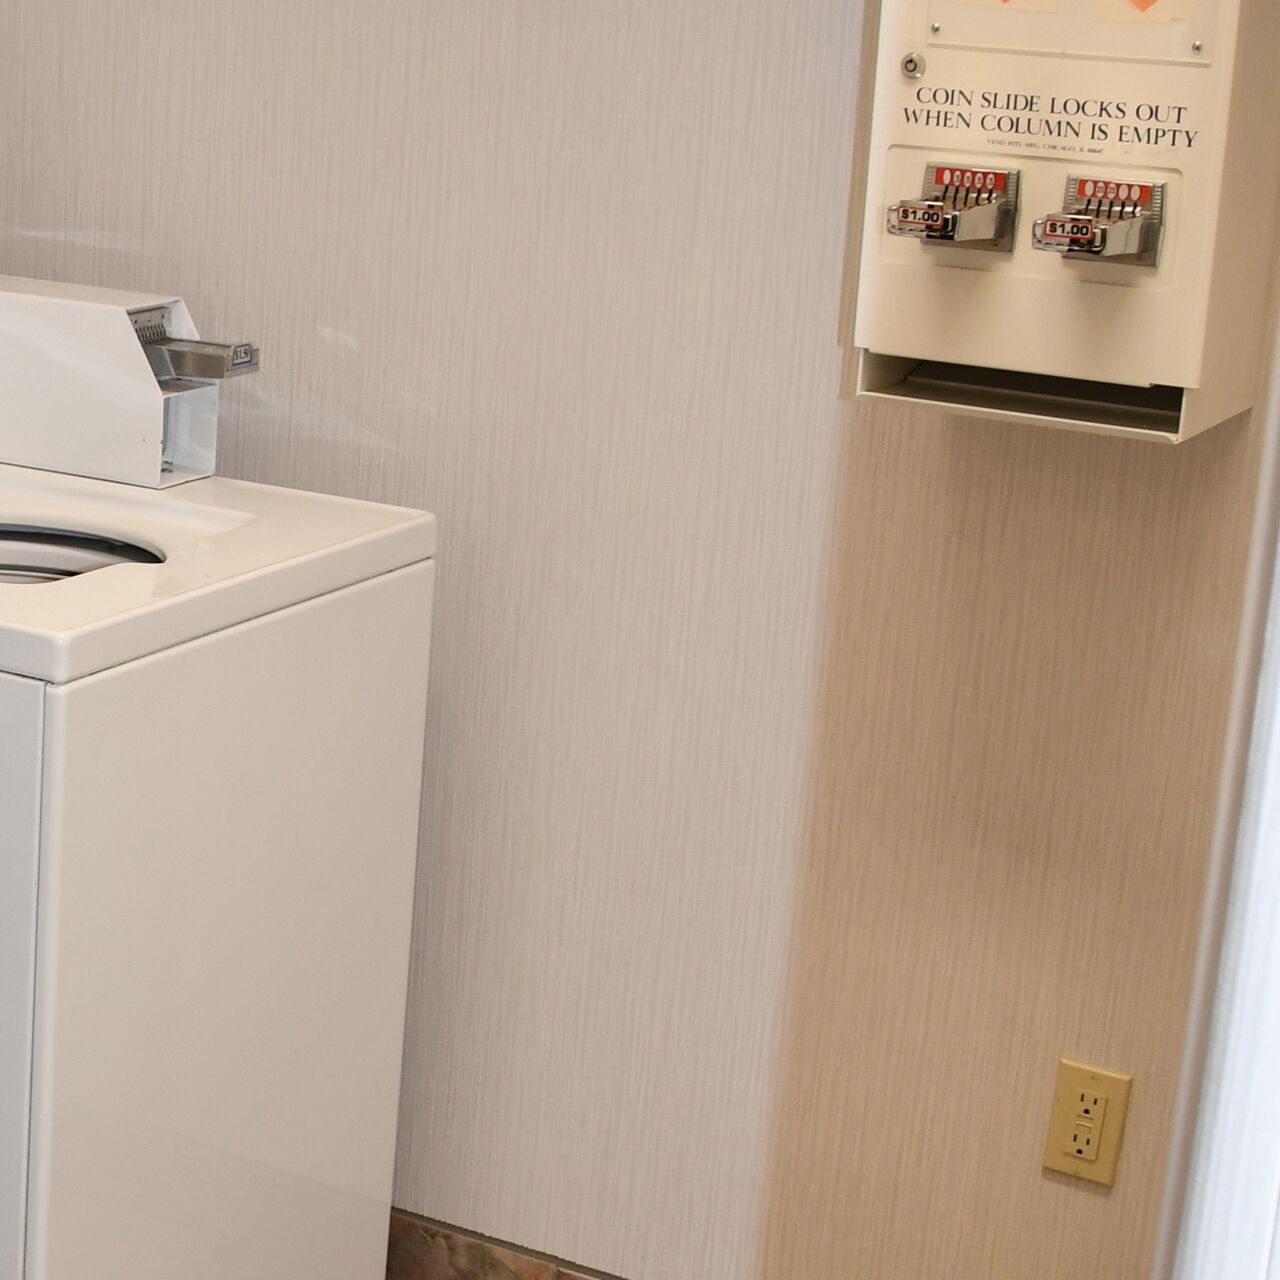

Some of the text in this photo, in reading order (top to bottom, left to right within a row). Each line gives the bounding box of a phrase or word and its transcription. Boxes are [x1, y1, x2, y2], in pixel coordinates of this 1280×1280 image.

[916, 86, 1187, 124] COIN SLIDE LOCKS OUT
[904, 107, 1198, 148] WHEN COLUMN IS EMPTY
[901, 209, 940, 223] $1.00
[1048, 223, 1089, 236] $1.00
